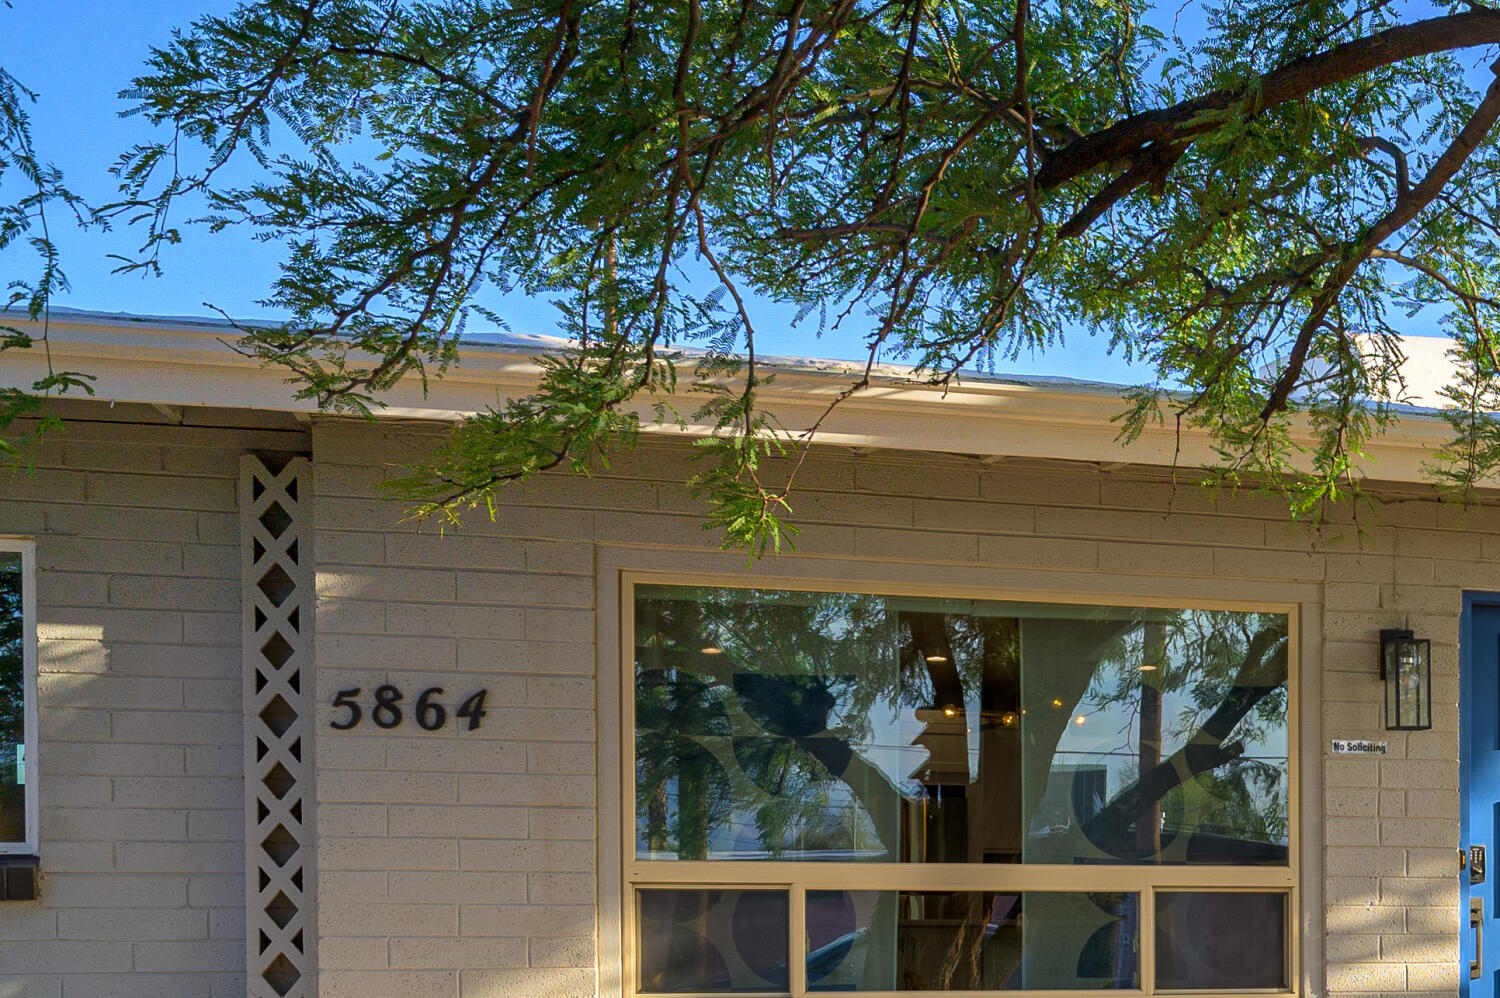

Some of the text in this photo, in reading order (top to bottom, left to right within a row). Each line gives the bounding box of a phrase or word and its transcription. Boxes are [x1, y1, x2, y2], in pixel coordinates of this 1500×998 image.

[330, 684, 488, 731] 5864
[1333, 742, 1386, 754] No Soliciting
